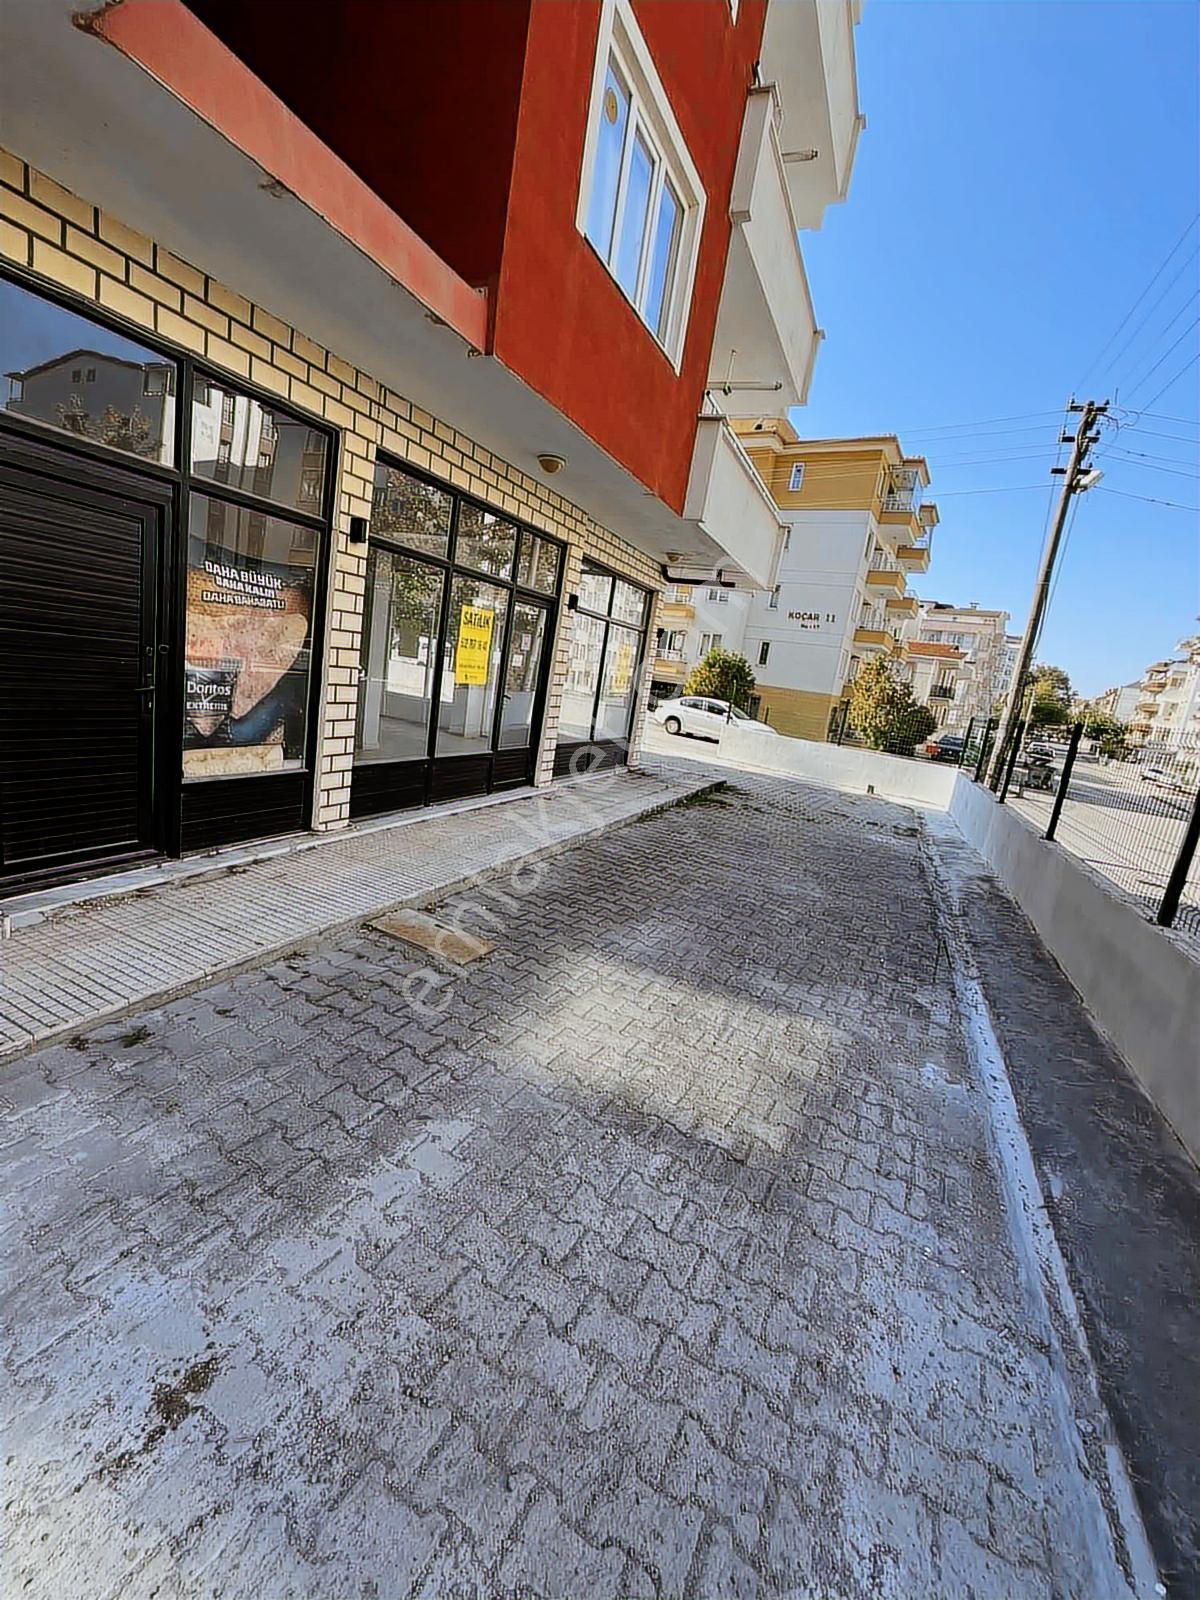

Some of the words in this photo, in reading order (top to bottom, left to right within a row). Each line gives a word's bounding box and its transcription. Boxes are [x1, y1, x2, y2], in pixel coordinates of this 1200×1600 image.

[205, 561, 239, 580] DAHA
[240, 570, 282, 589] BÜYÜK
[215, 576, 244, 591] DAHA
[202, 591, 233, 604] DAHA
[187, 680, 231, 696] Doritos
